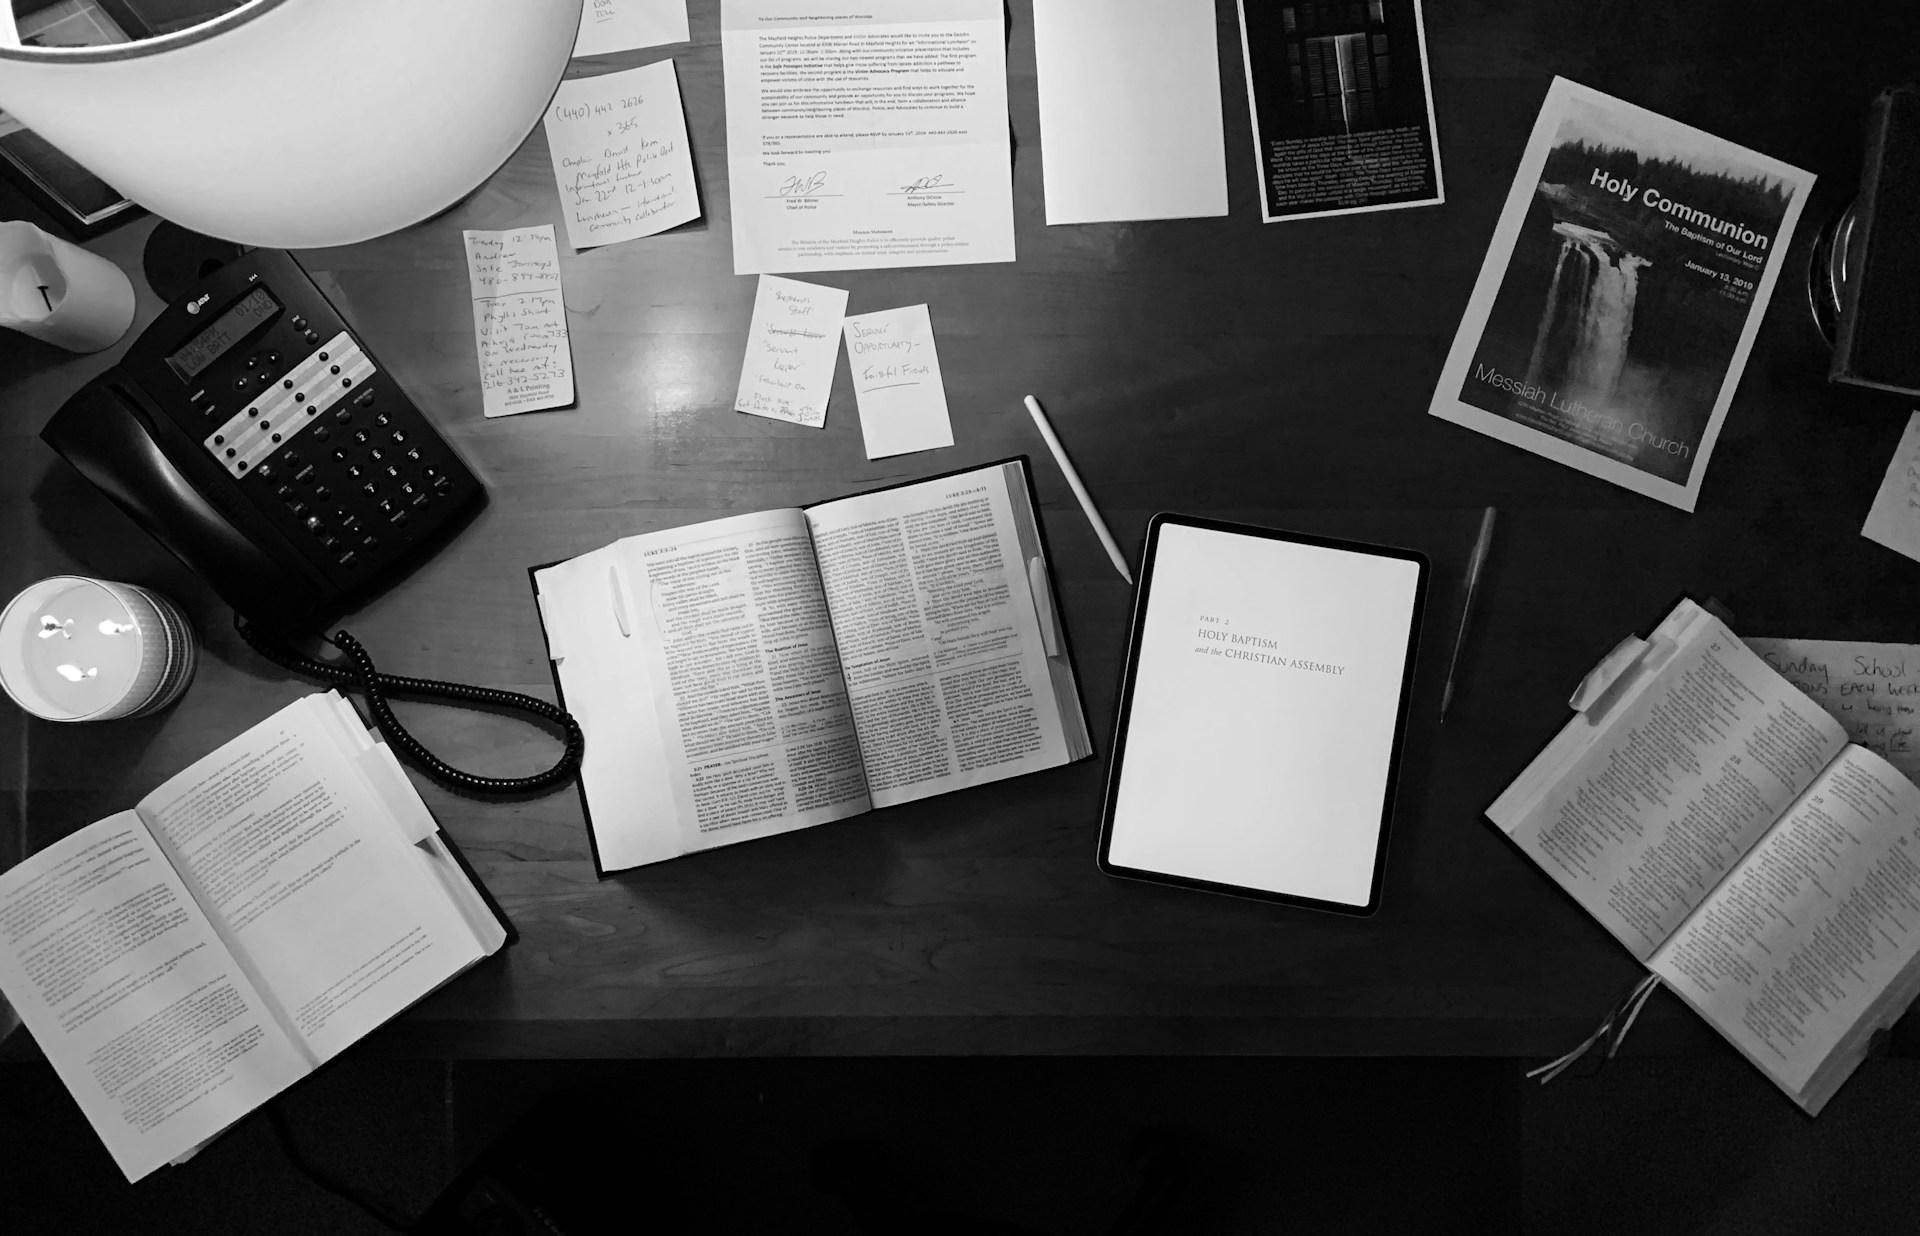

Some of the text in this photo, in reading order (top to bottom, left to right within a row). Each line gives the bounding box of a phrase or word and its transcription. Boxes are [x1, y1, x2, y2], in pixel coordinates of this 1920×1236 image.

[556, 95, 644, 121] (440) 442 2626
[616, 116, 638, 135] 365
[1589, 167, 1770, 251] Holy Communion
[1664, 220, 1764, 265] The Baptism of Our Lord
[1684, 260, 1754, 291] January 13, 2019
[1474, 362, 1547, 405] Messiah
[1550, 391, 1624, 435] Lutheran
[1627, 421, 1691, 460] Church
[1199, 615, 1220, 624] PART
[1198, 628, 1278, 650] HOLY BAPTISM
[1194, 646, 1345, 676] and the CHRISTIAN ASSEMBLY
[1763, 652, 1907, 685] Sunday School
[1729, 754, 1743, 766] 28
[1812, 794, 1825, 806] 29
